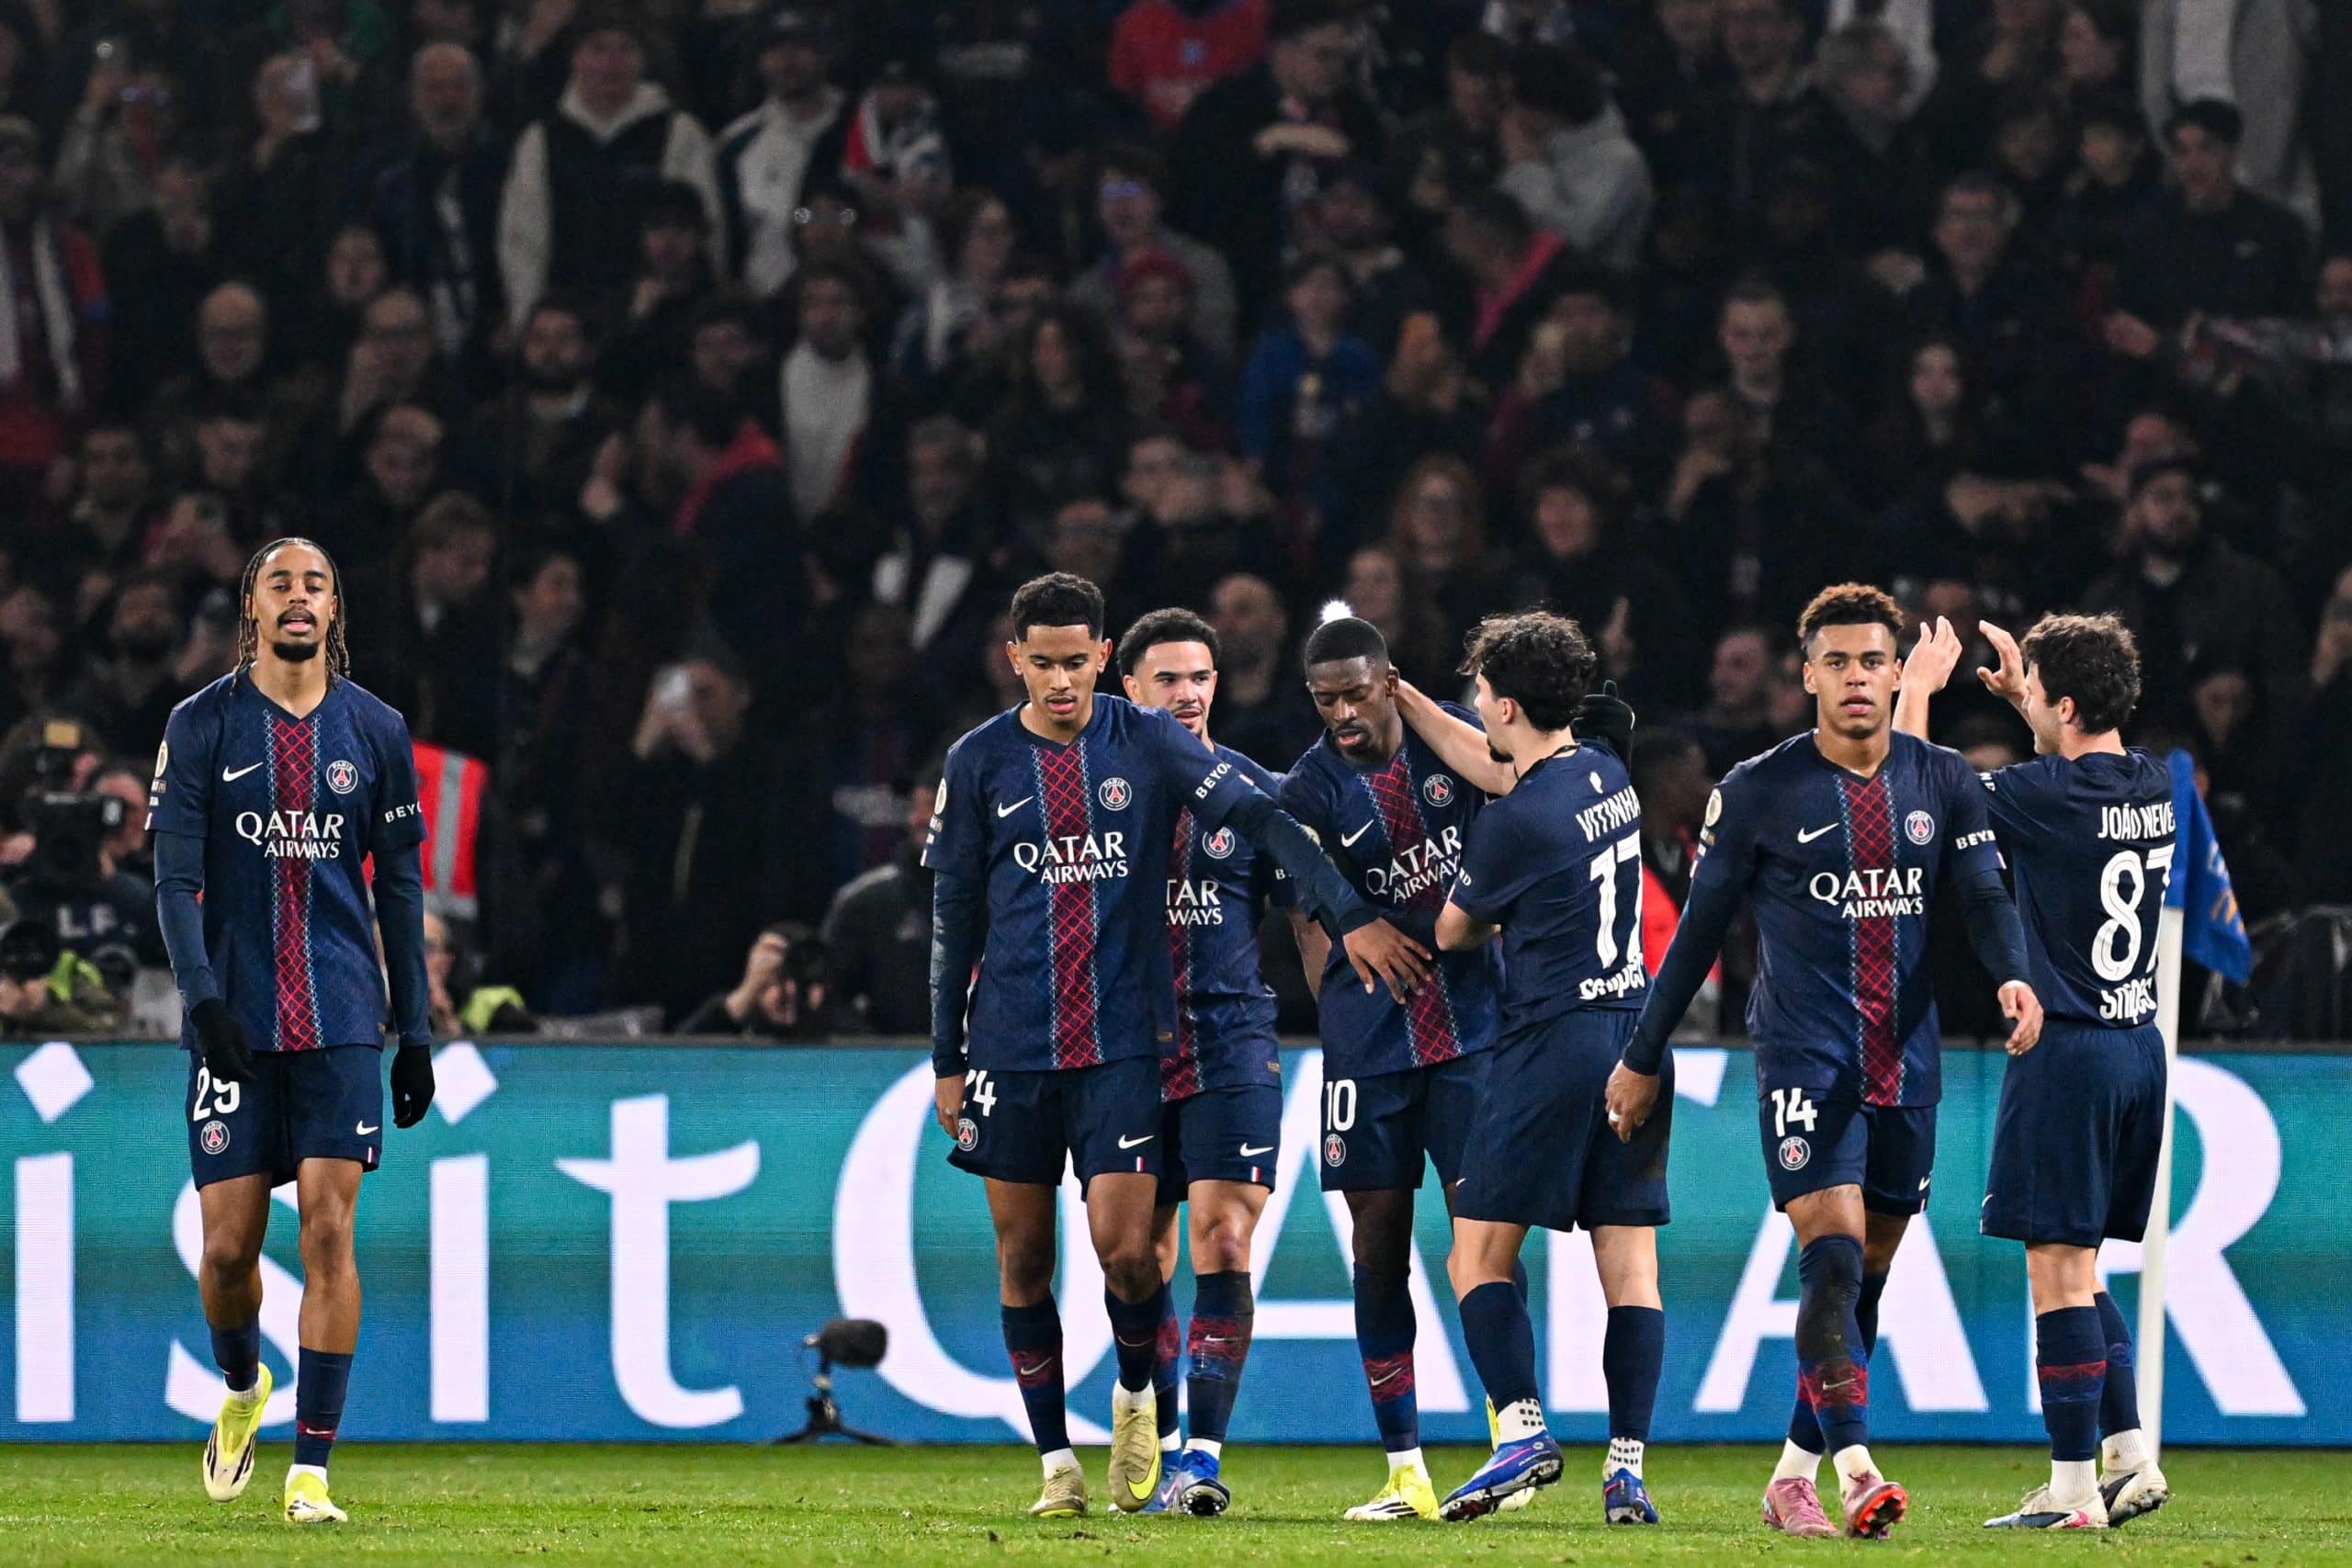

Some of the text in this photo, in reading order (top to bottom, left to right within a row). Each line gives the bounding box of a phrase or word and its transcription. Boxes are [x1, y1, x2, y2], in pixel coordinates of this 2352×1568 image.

[235, 810, 345, 846] QATAR
[1576, 785, 1641, 842] VITINHA
[2139, 801, 2176, 839] NEVE
[264, 840, 341, 859] AIRWAYS
[1013, 831, 1126, 874] QATAR
[1366, 826, 1463, 896] QATAR
[1040, 860, 1128, 885] AIRWAYS
[1166, 879, 1221, 907] TAR
[1394, 851, 1461, 905] AIRWAY
[1809, 867, 1923, 906] QATAR
[1167, 908, 1223, 926] WAYS
[1590, 829, 1643, 970] 17
[1841, 897, 1924, 919] AIRWAYS
[2092, 843, 2176, 982] 87
[193, 1066, 241, 1122] 29
[1326, 1078, 1357, 1132] 10
[1770, 1087, 1818, 1138] 14
